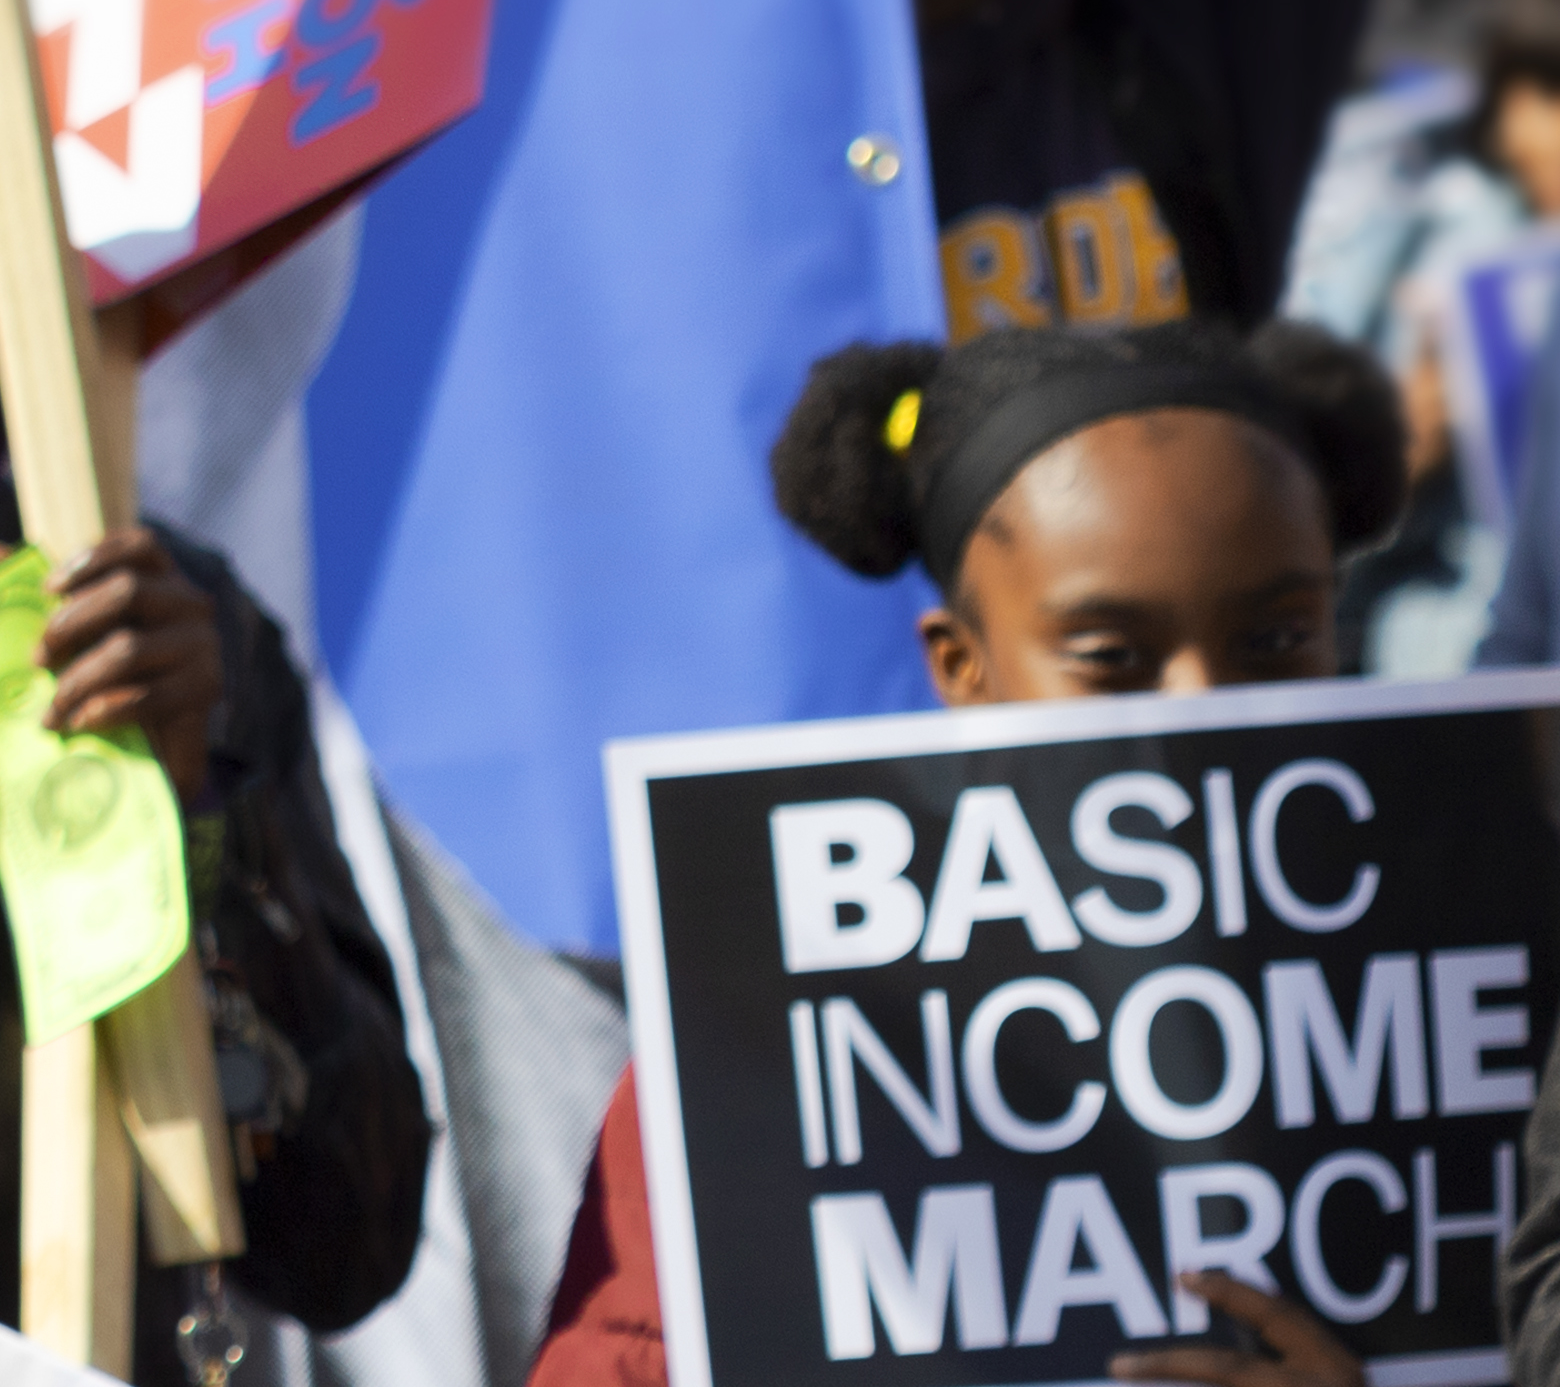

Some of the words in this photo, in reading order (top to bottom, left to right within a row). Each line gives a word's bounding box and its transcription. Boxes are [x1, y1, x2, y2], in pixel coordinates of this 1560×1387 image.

[769, 757, 1381, 974] BASIC
[789, 943, 1538, 1168] INCOME
[809, 1139, 1516, 1362] MARCH
